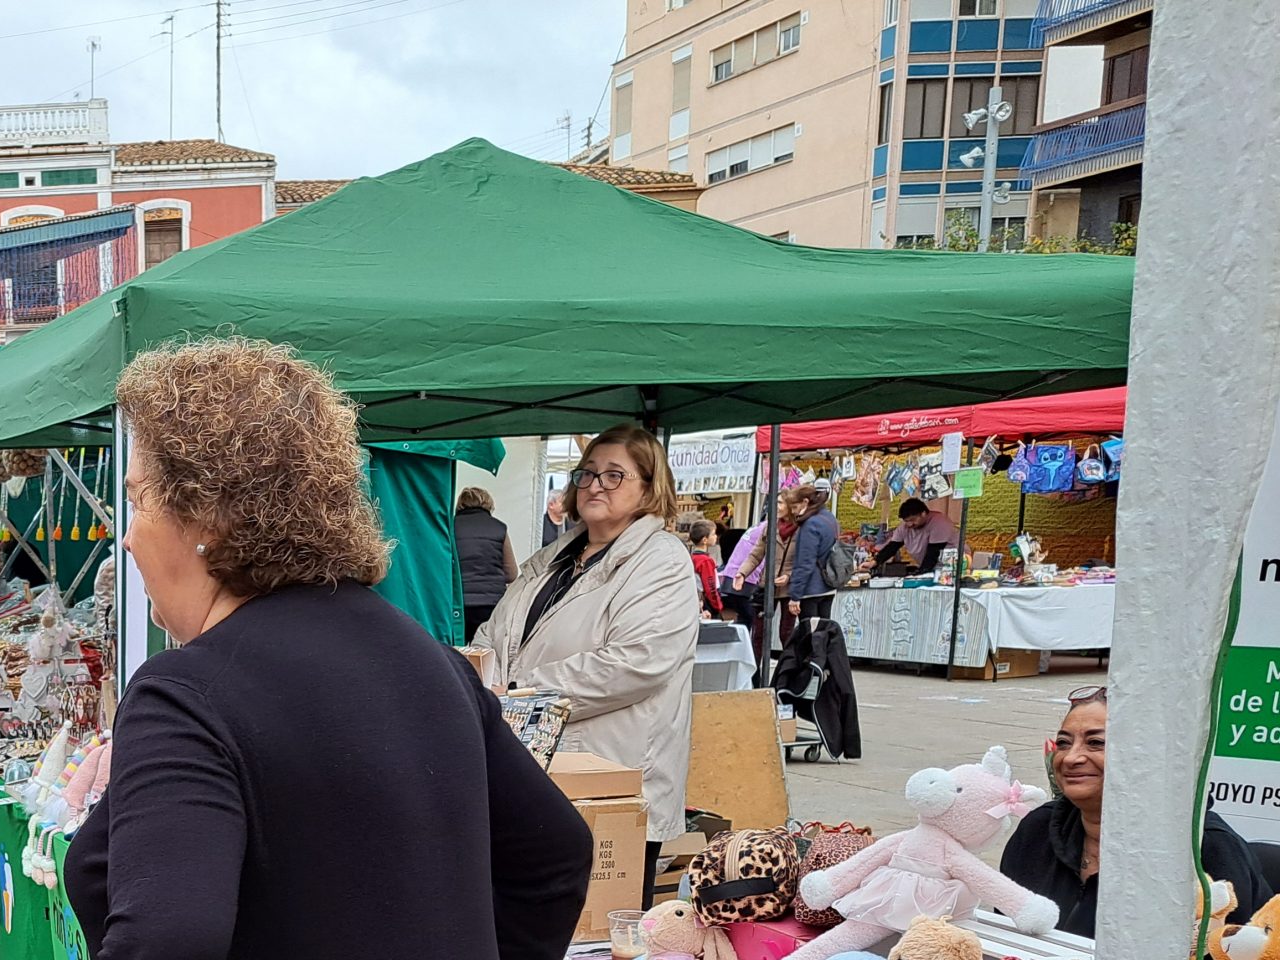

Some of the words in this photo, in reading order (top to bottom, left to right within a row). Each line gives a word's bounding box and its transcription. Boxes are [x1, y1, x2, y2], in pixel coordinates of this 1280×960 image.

[669, 443, 719, 467] tunidad
[1229, 689, 1263, 713] de
[1229, 724, 1247, 746] y
[599, 851, 612, 859] KGS
[600, 840, 613, 849] KGS
